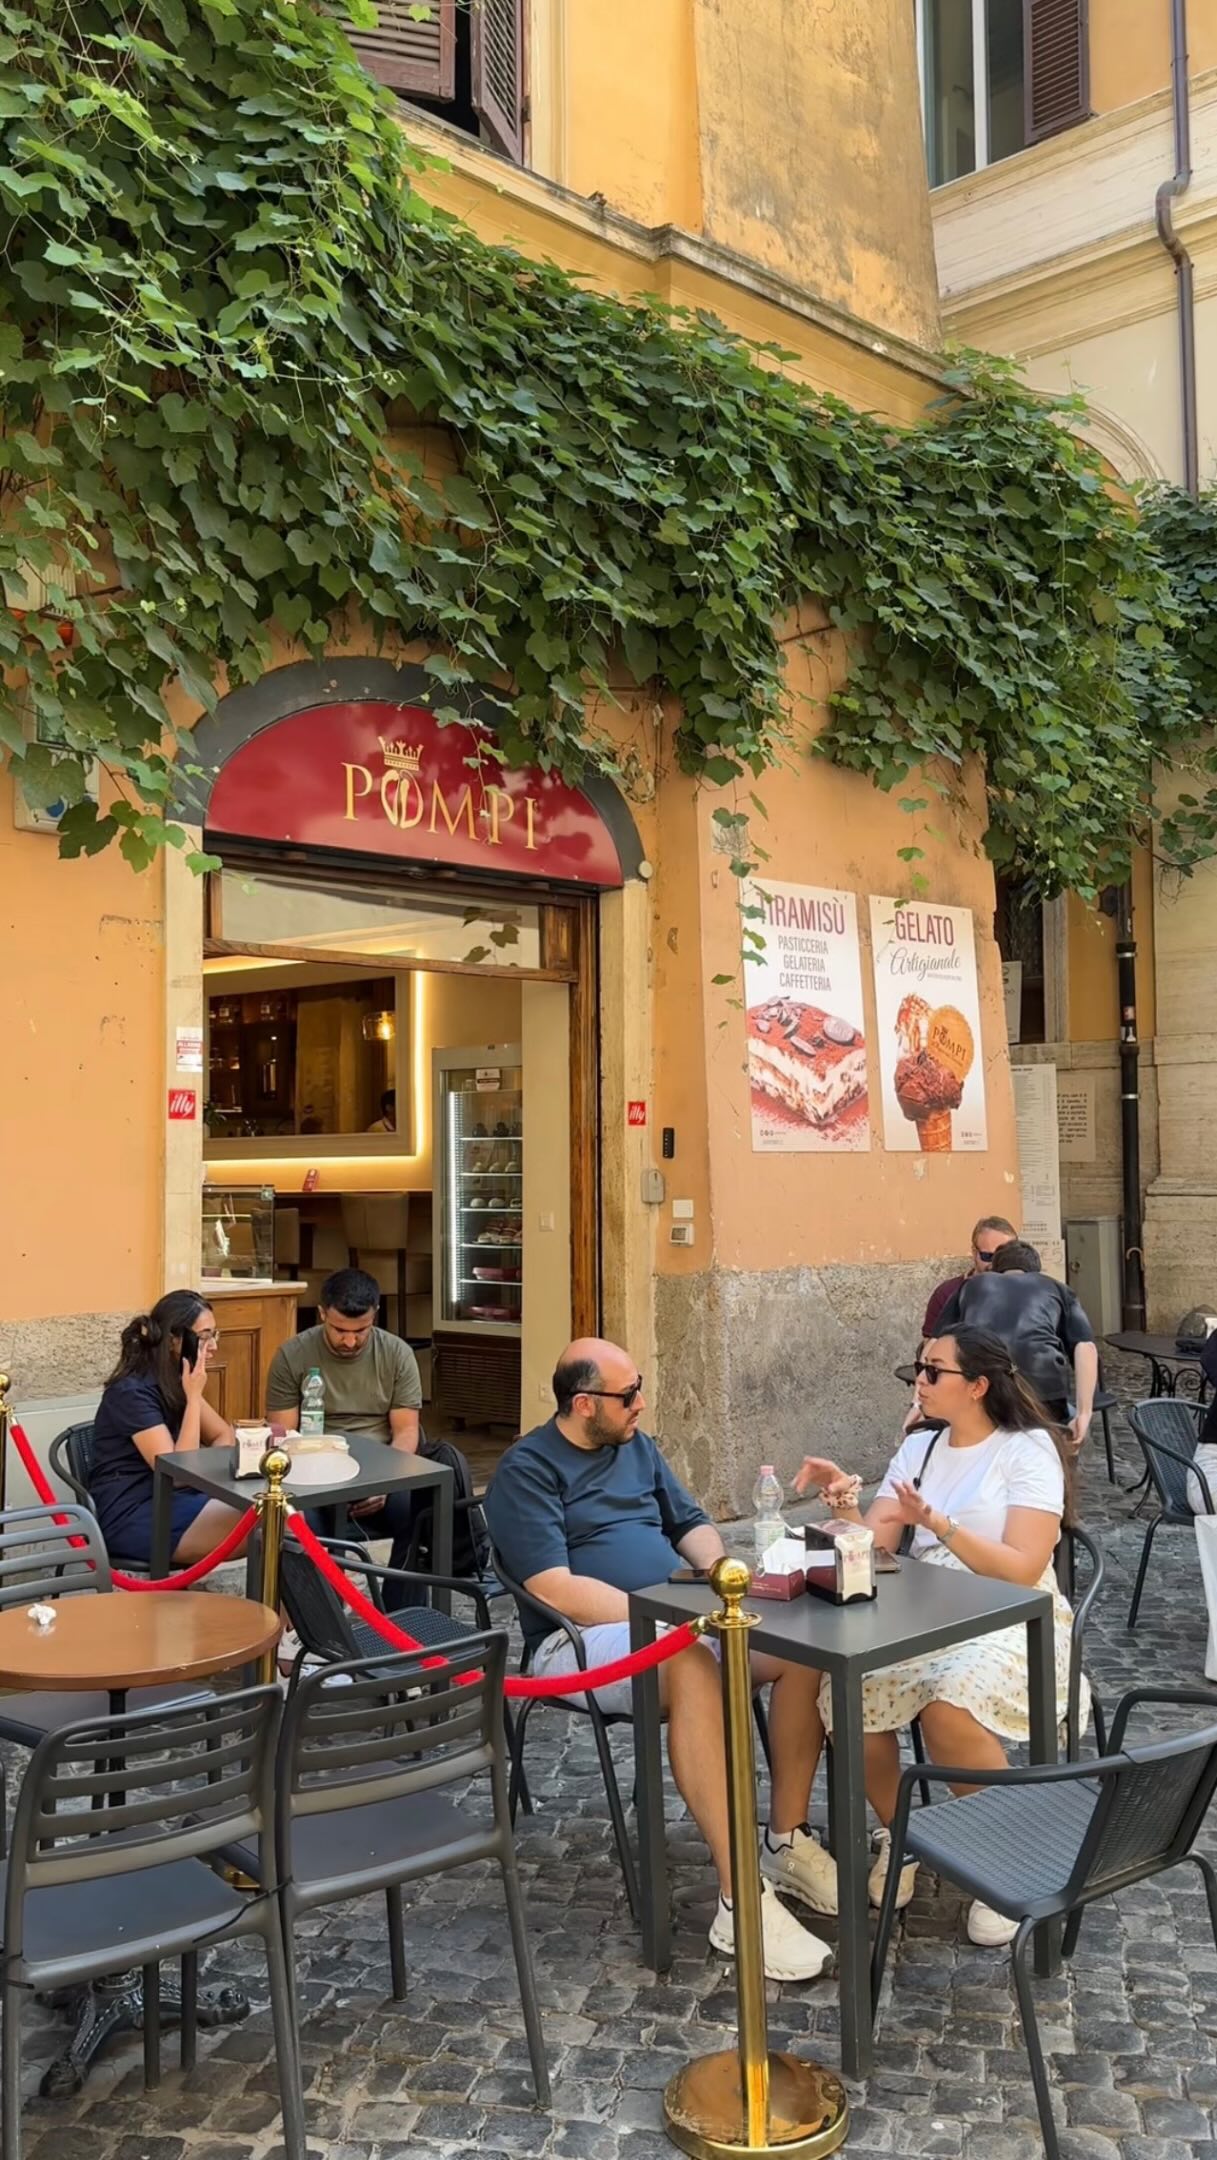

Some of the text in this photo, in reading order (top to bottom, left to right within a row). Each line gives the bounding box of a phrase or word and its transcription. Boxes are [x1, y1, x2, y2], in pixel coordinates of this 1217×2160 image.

[341, 762, 538, 850] POMPI
[895, 910, 955, 946] GELATO
[778, 935, 829, 955] PASTICCERIA
[783, 954, 826, 972] GELATERIA
[890, 946, 960, 981] Artigianale
[779, 972, 832, 992] CAFFETTERIA
[932, 1025, 967, 1061] POMPI
[170, 1093, 194, 1117] illy
[629, 1103, 646, 1124] illy
